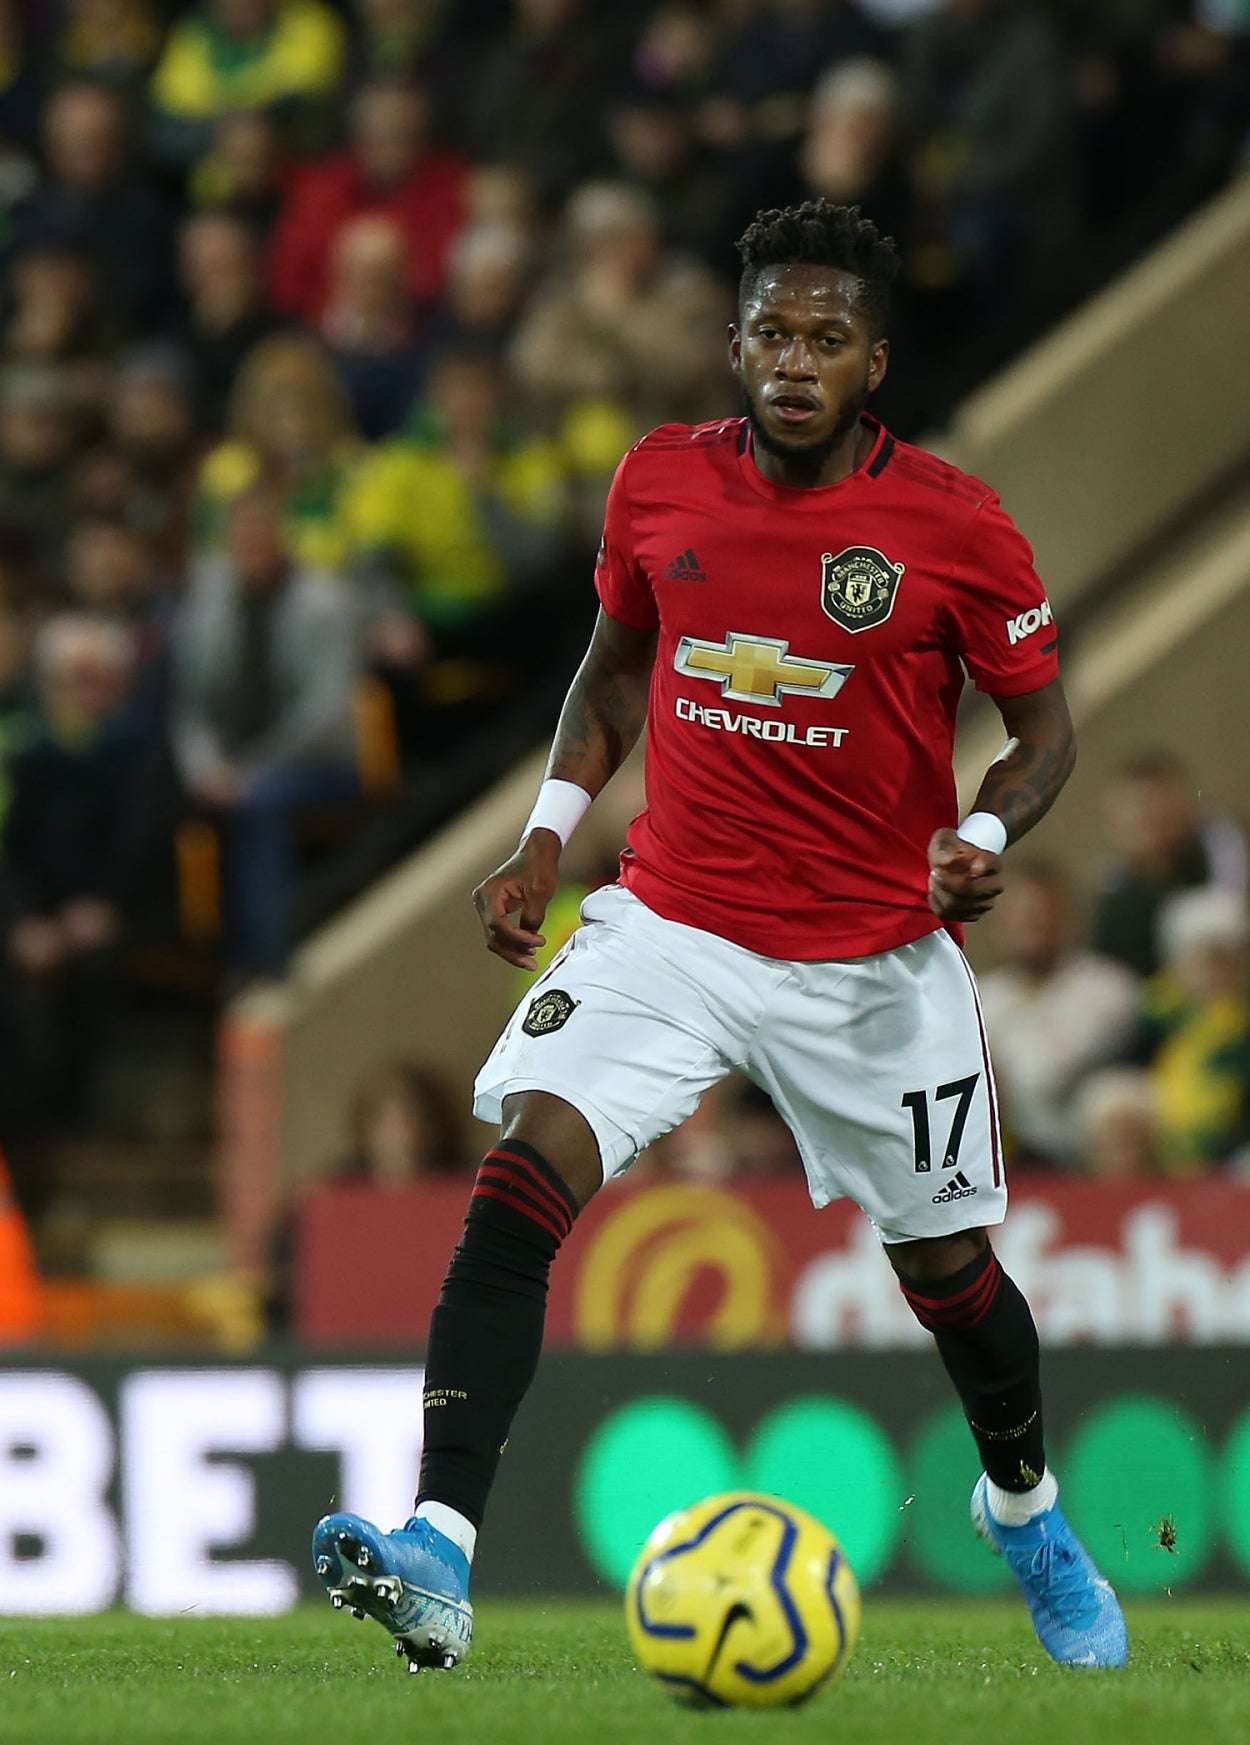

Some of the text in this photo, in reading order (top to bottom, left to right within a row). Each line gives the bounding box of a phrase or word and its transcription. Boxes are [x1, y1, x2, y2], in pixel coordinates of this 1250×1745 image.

[663, 568, 708, 583] adidas
[836, 560, 886, 585] MANCHESTER
[840, 601, 873, 614] UNITED
[675, 697, 849, 747] CHEVROLET
[901, 1072, 981, 1173] 17
[931, 1186, 978, 1205] adidas
